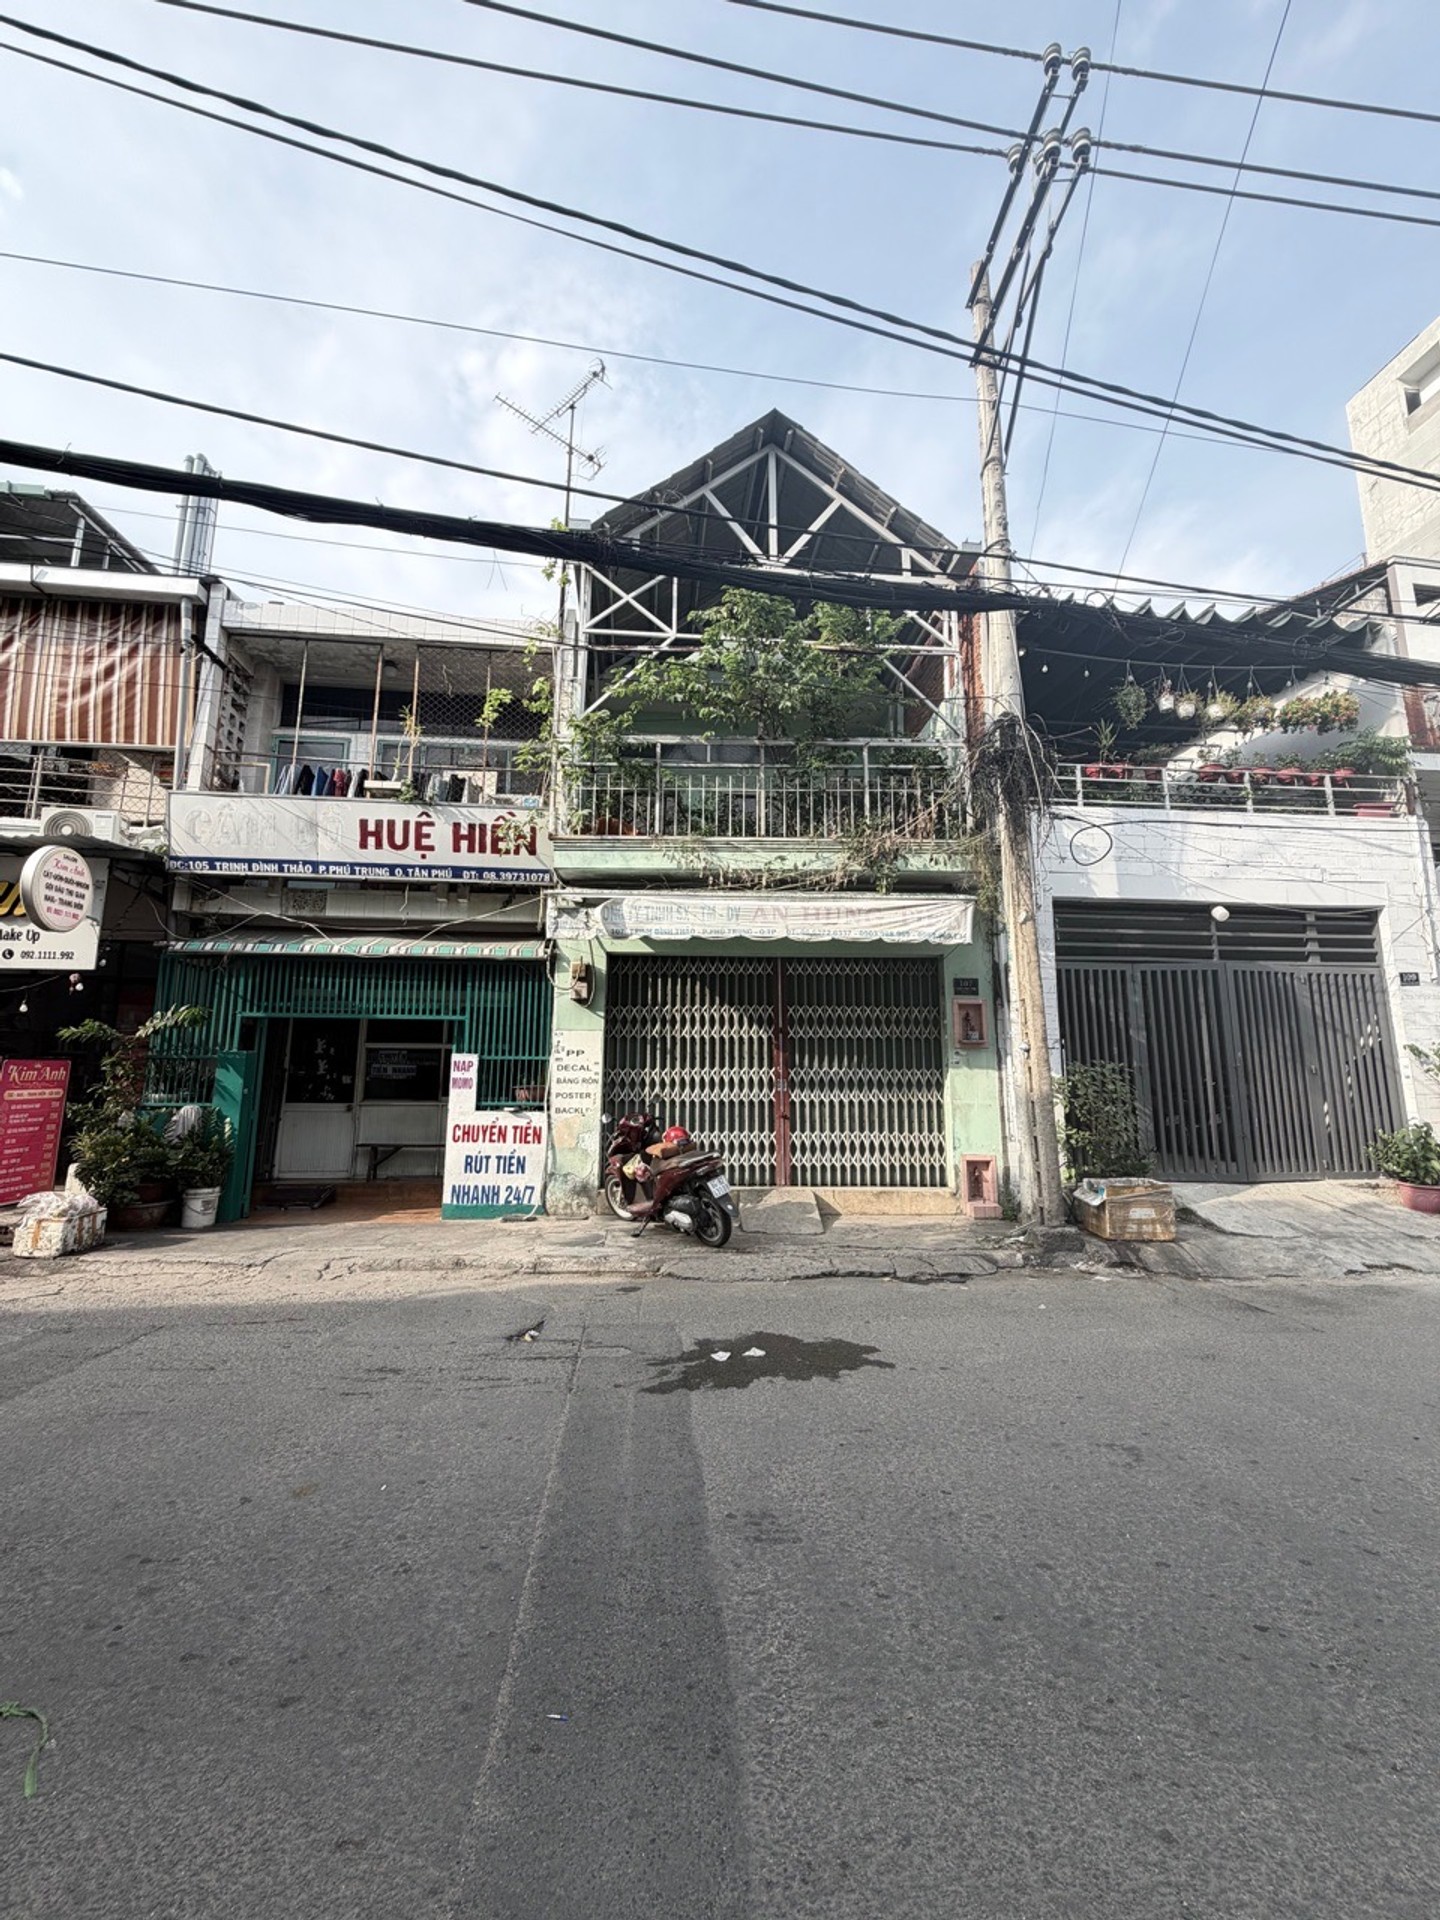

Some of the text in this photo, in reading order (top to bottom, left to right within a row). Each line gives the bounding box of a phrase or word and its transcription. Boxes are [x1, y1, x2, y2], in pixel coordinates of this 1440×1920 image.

[359, 811, 537, 860] HUỆ HIỀN
[251, 860, 278, 873] ĐÌNH
[354, 866, 390, 877] TRUNG
[431, 867, 453, 878] PHÚ
[25, 929, 41, 944] Up
[20, 950, 75, 960] 092.1111.992
[8, 1064, 67, 1086] Kim Anh
[453, 1060, 474, 1075] NẠP
[556, 1064, 593, 1072] DECAL
[451, 1077, 474, 1090] MOMO
[452, 1116, 543, 1145] CHUYỂN TIỀN
[464, 1149, 527, 1174] RÚT TIỀN
[451, 1184, 536, 1205] NHANH 24/7
